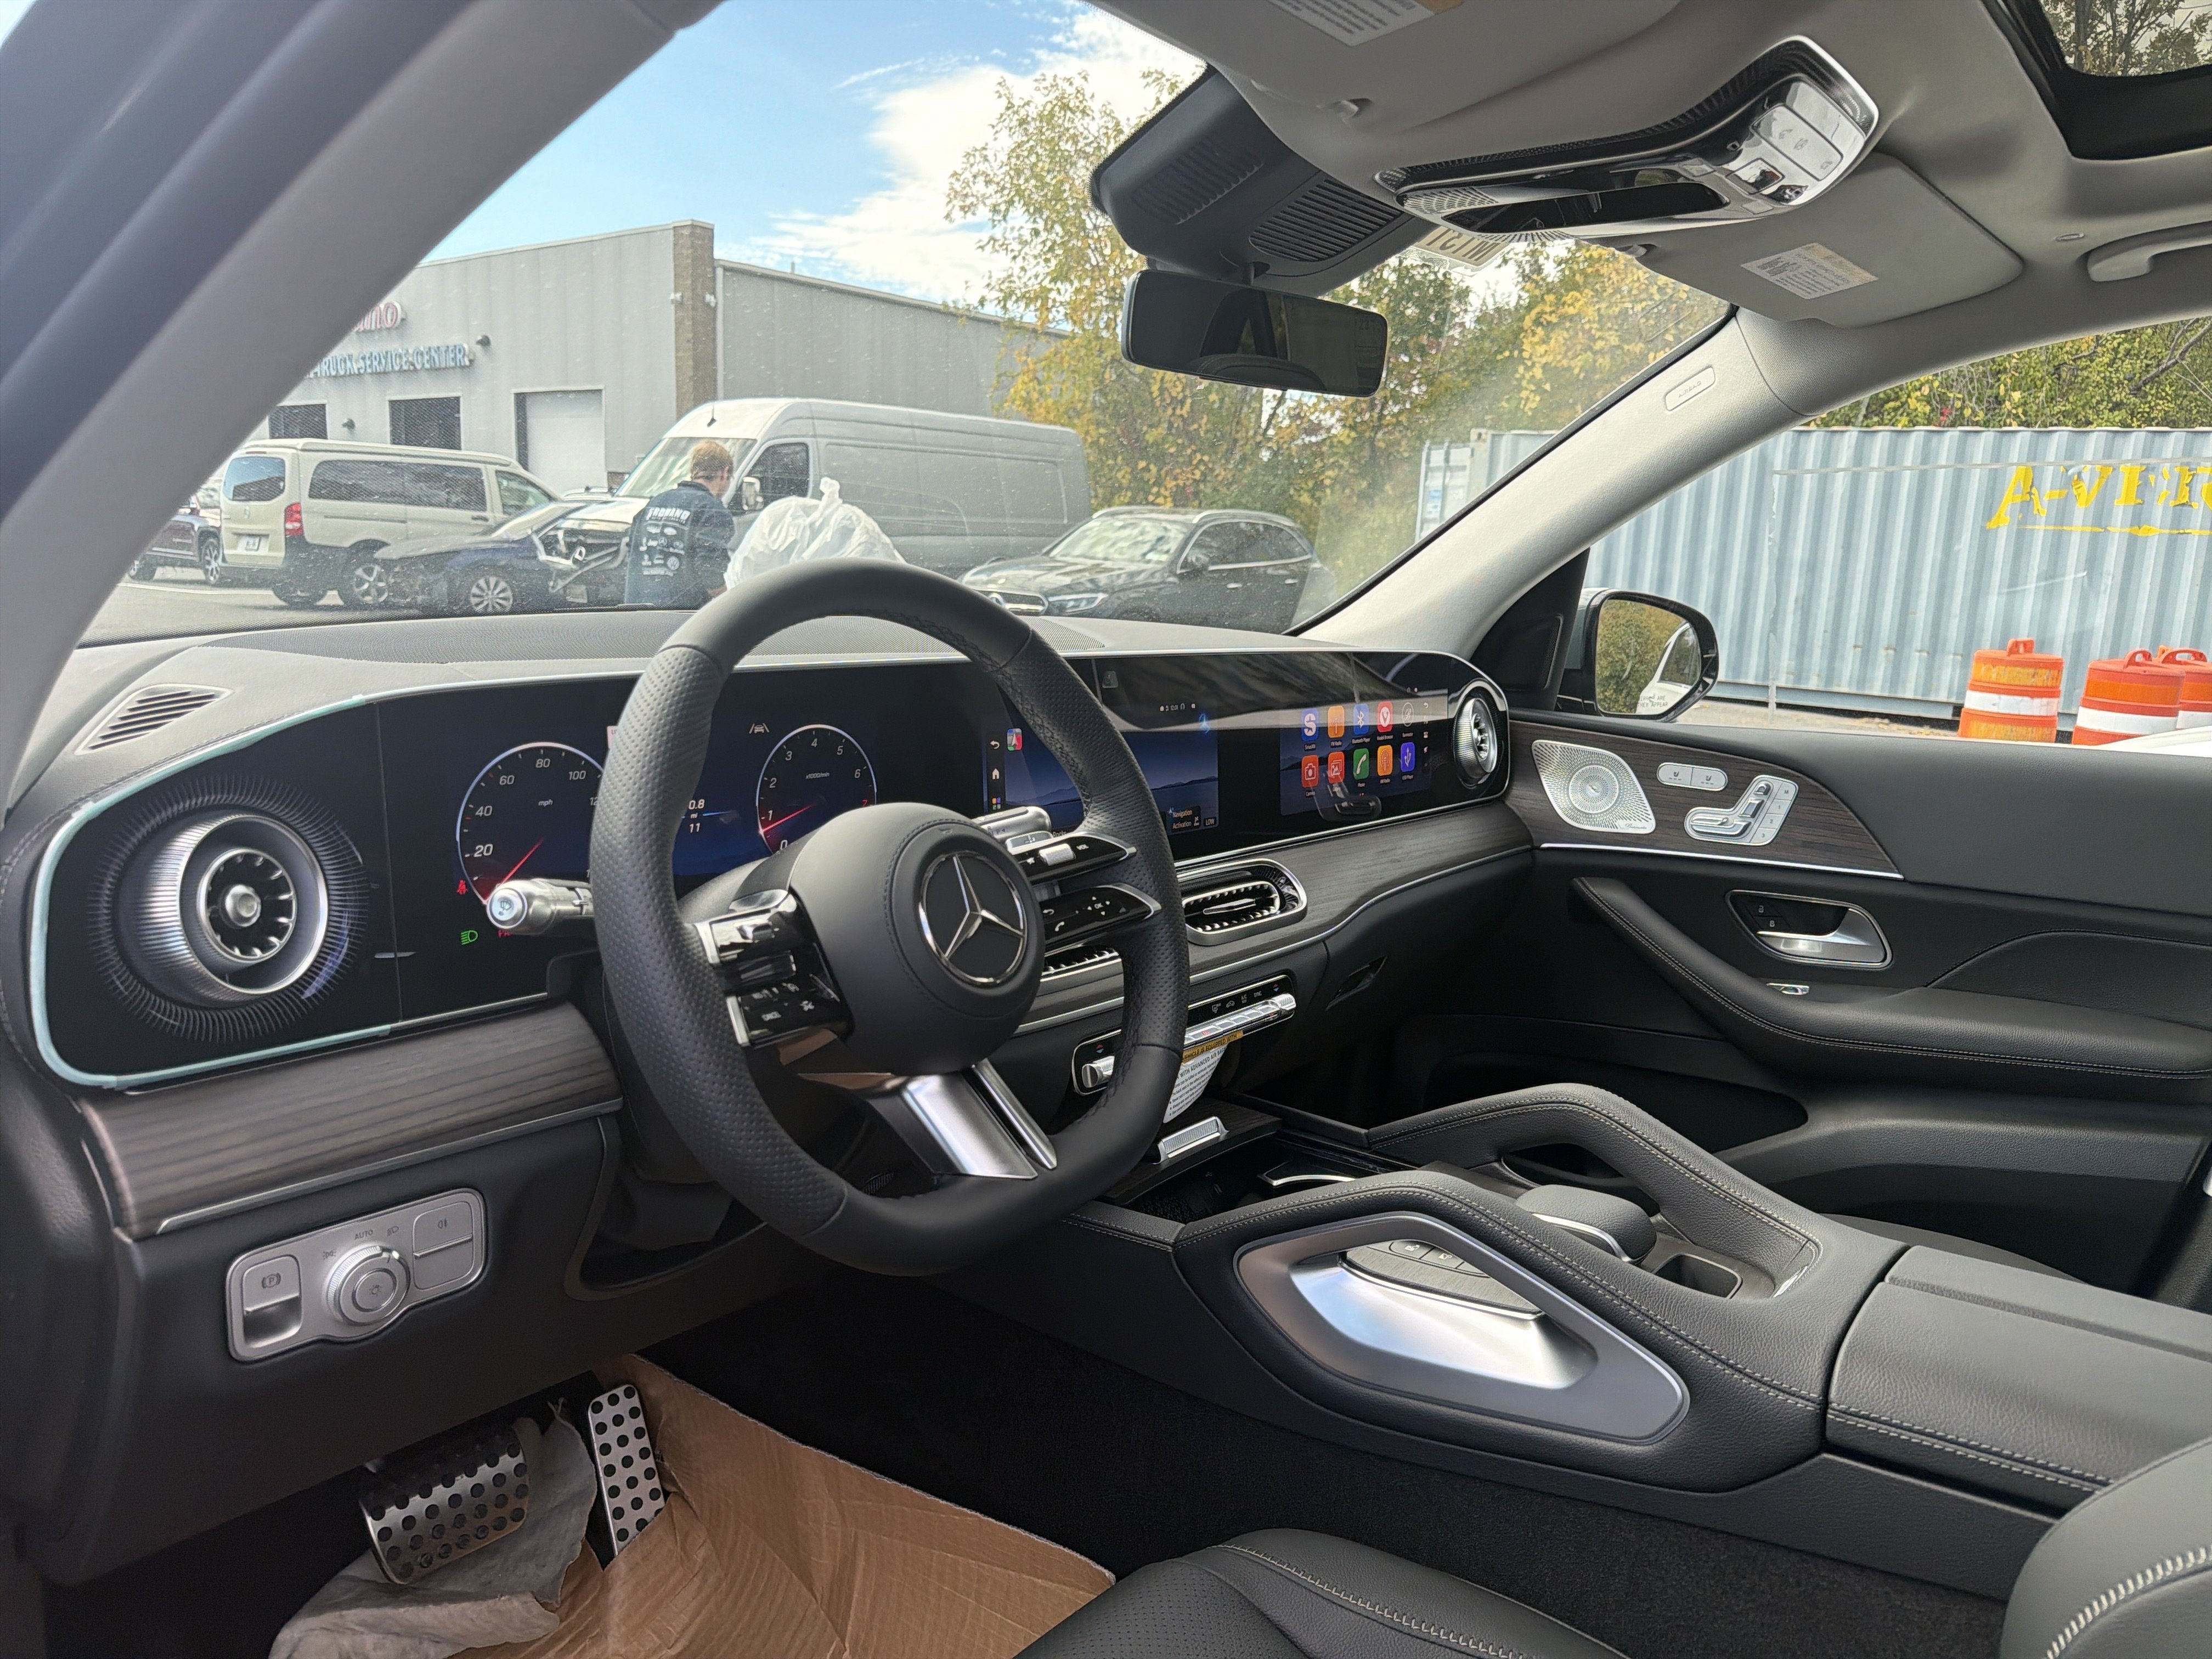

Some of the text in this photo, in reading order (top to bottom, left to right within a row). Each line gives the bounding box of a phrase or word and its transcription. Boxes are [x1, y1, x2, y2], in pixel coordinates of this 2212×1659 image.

[358, 348, 409, 374] SERVICE
[413, 343, 466, 370] CENTER
[811, 738, 818, 748] 4
[836, 745, 844, 755] 5
[785, 751, 793, 761] 3
[535, 758, 550, 768] 80
[568, 770, 586, 780] 100
[854, 769, 861, 779] 6
[499, 775, 515, 785] 60
[769, 777, 777, 788] 2
[589, 796, 599, 806] 12
[688, 799, 705, 810] 0.8
[861, 799, 868, 808] 7
[475, 805, 493, 817] 40
[768, 810, 772, 821] 1
[1172, 809, 1193, 819] Navigation
[689, 823, 701, 833] 11
[1172, 820, 1192, 829] Activation
[780, 839, 788, 850] 0
[473, 844, 493, 857] 20
[1205, 1039, 1226, 1051] EQUIPPED
[1226, 1033, 1237, 1042] WITH
[1180, 1068, 1190, 1077] WITH
[1190, 1056, 1210, 1071] ADVANCED
[354, 1229, 374, 1240] AUTO
